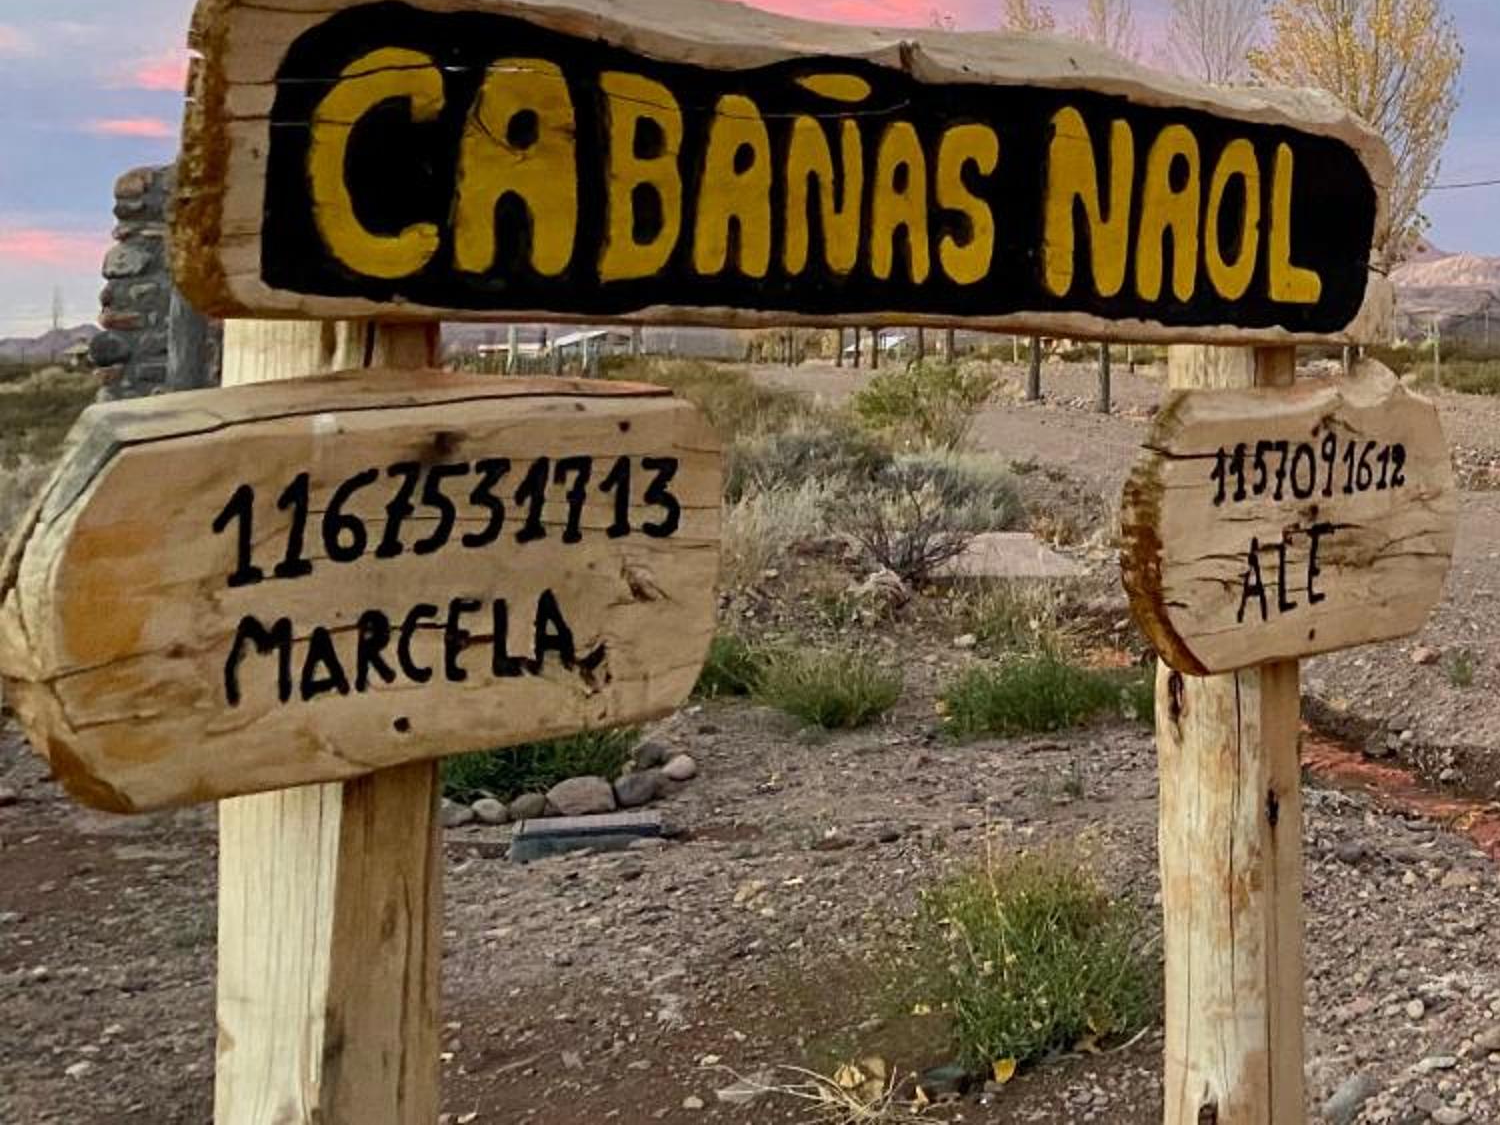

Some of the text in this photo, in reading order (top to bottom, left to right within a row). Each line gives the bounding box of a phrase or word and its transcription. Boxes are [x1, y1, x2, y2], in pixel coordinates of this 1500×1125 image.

[306, 46, 1323, 305] CABAÑAS NAOL
[212, 455, 681, 588] 1167531713
[1210, 431, 1406, 507] 1157091612
[1237, 522, 1336, 623] ALE
[224, 588, 579, 707] MARCELA
